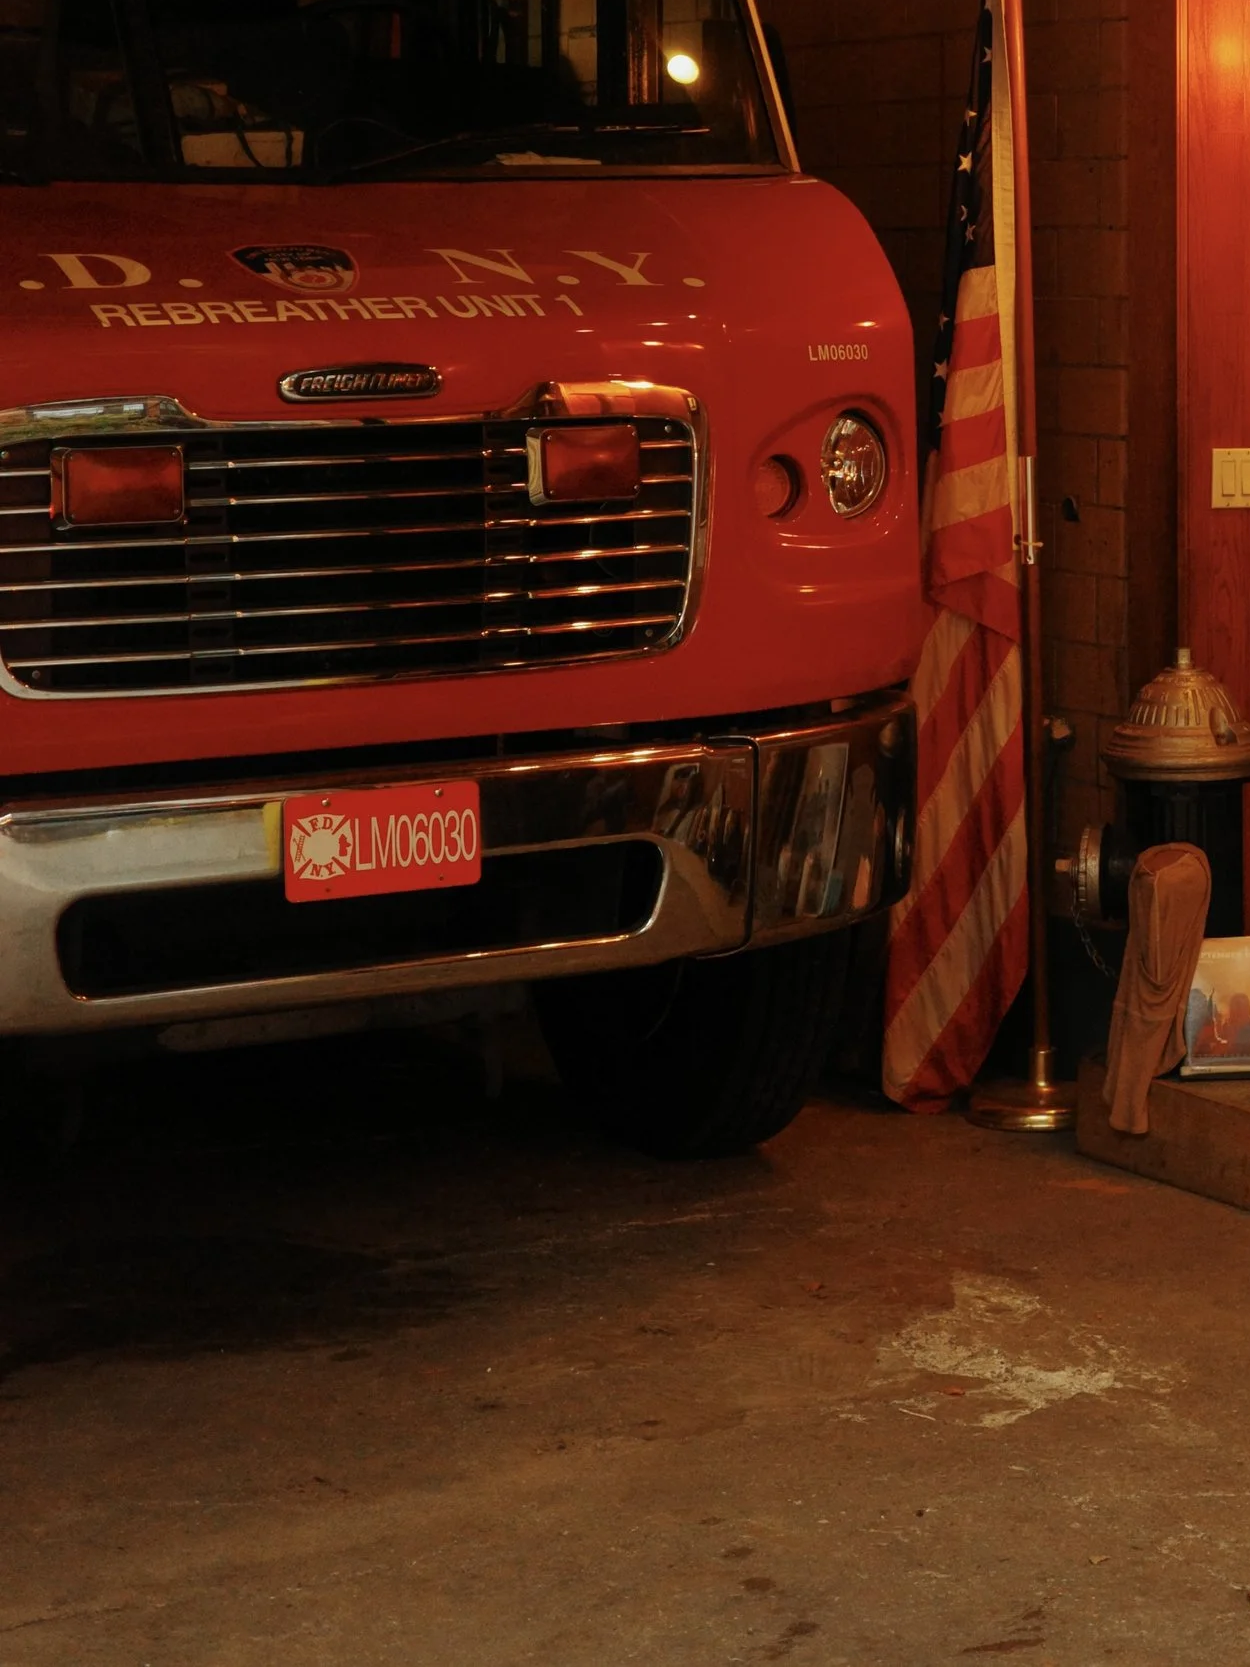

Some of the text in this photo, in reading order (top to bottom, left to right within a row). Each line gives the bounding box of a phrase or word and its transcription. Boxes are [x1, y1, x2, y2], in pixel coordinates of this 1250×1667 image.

[90, 294, 584, 328] REBREATHER UNIT 1
[808, 343, 869, 362] LM06030
[354, 808, 477, 871] LM06030
